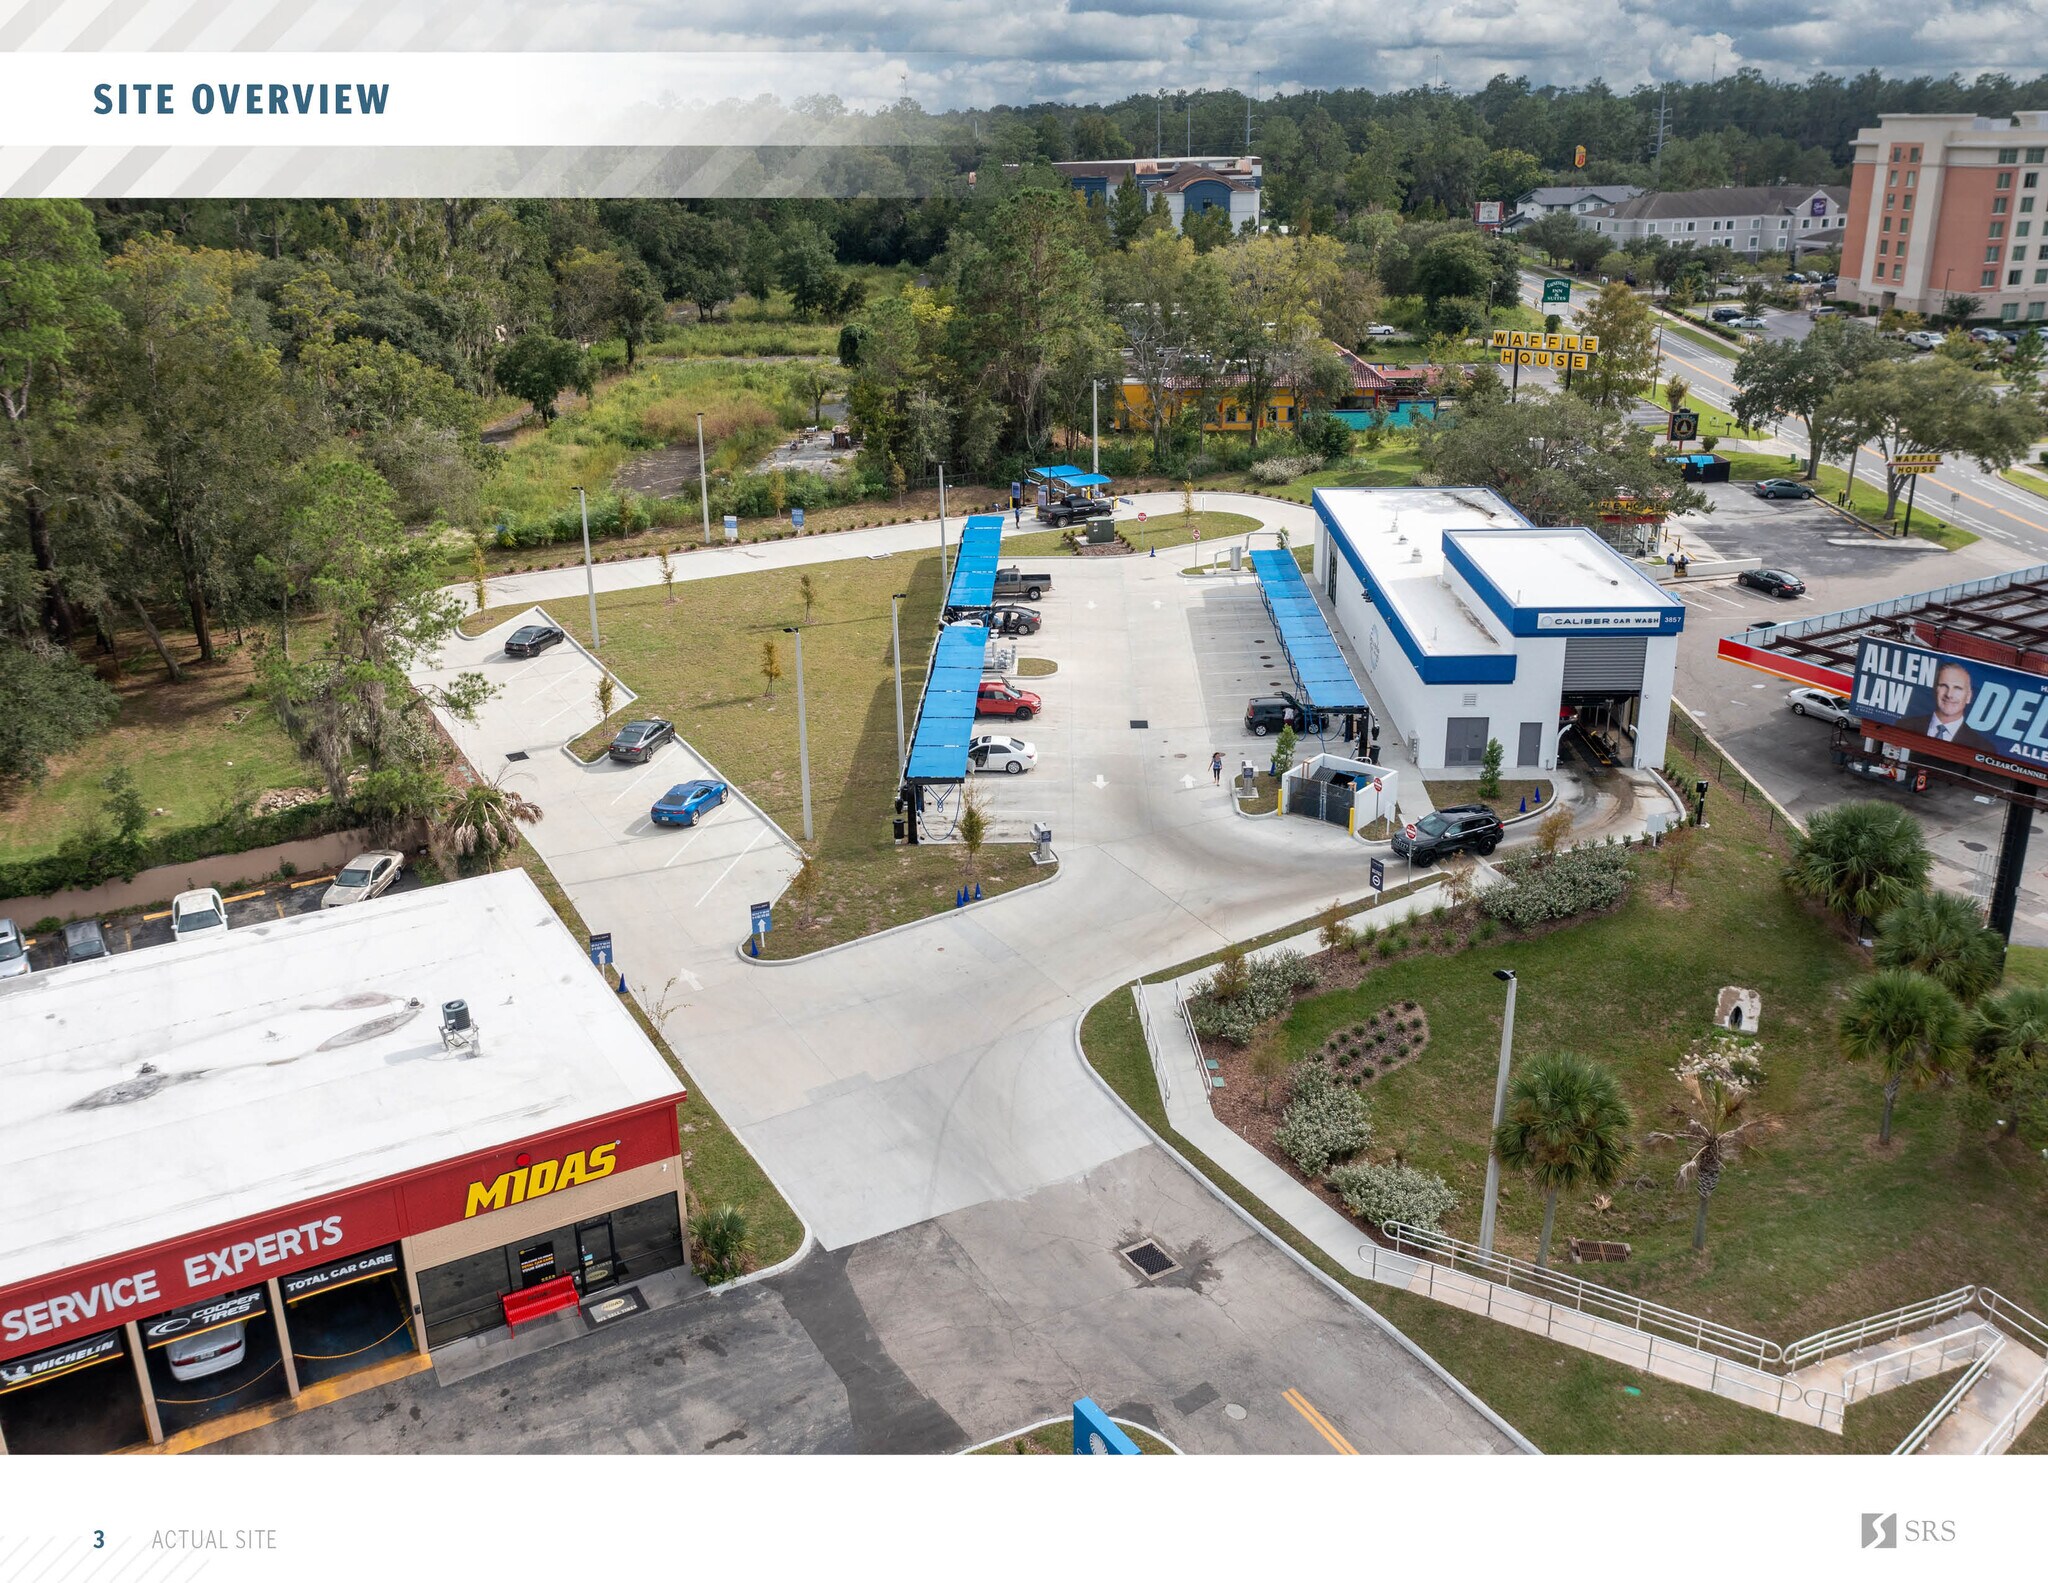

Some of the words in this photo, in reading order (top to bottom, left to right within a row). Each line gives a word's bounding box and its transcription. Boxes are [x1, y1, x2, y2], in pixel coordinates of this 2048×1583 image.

[1495, 333, 1594, 351] WAFFLE
[1503, 351, 1583, 368] HOUSE
[1898, 466, 1935, 474] HOUSE
[1861, 642, 1938, 689] ALLEN
[1856, 674, 1913, 715] LAW
[464, 1142, 617, 1219] MIDAS
[1, 1270, 161, 1342] SERVICE
[183, 1215, 343, 1287] EXPERTS
[287, 1273, 329, 1292] TOTAL
[330, 1264, 357, 1278] CAR
[359, 1253, 393, 1269] CARE
[191, 1292, 260, 1320] COOPER
[201, 1302, 250, 1324] TIRES
[32, 1340, 114, 1373] MICHELIN
